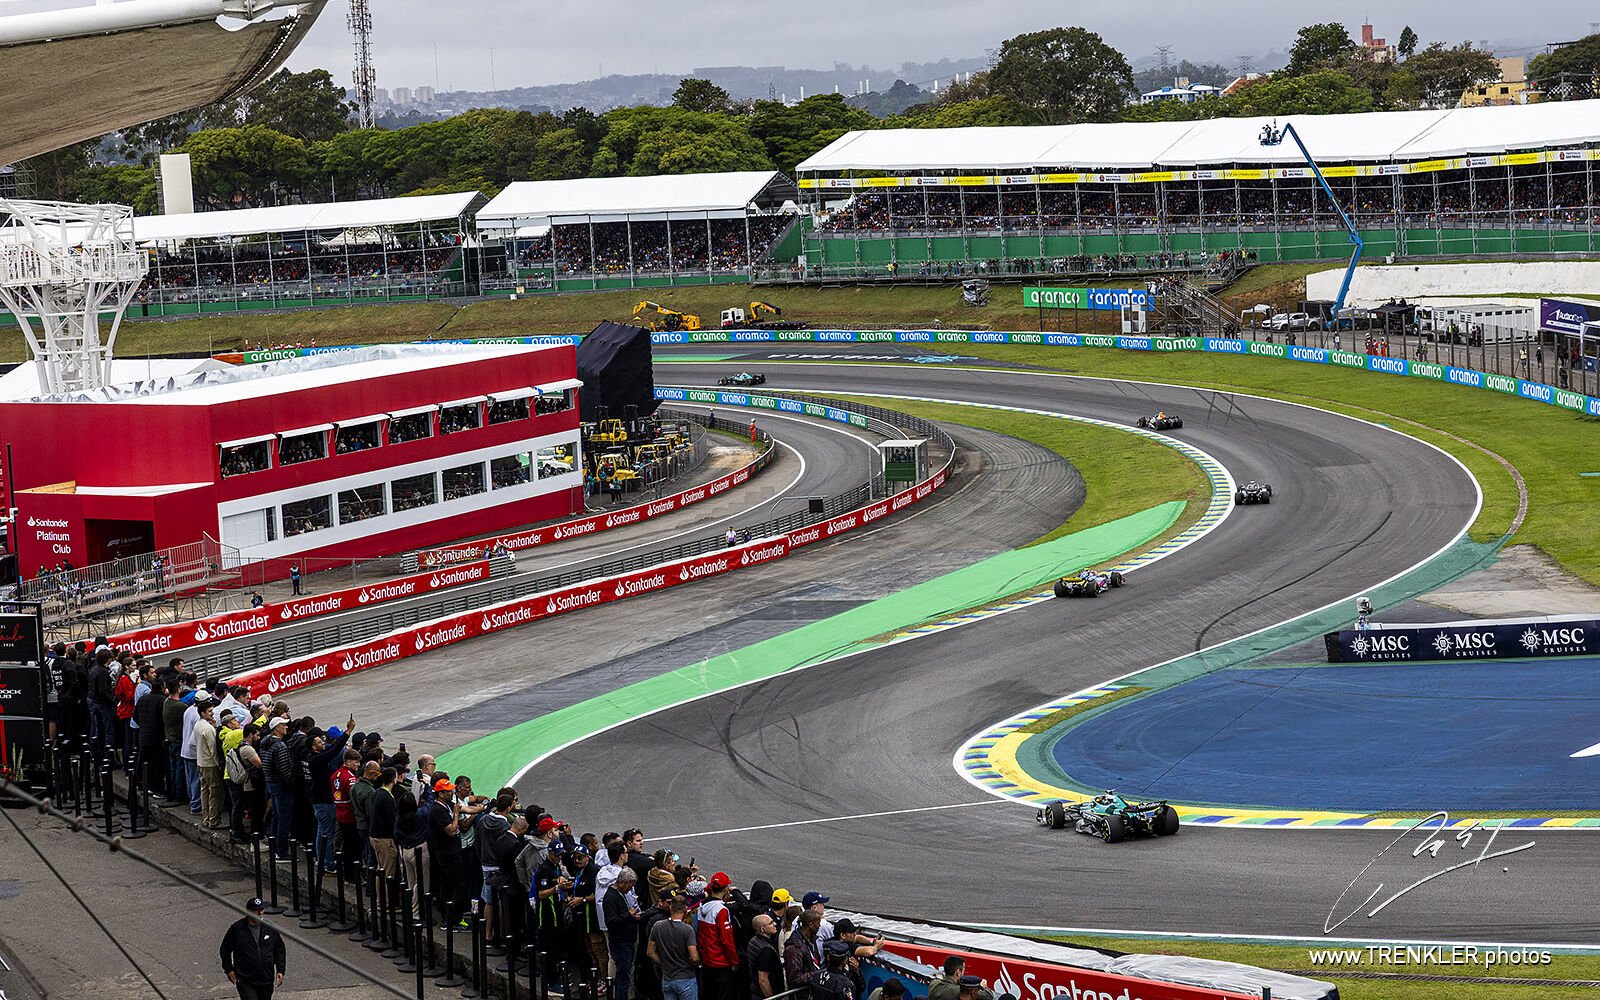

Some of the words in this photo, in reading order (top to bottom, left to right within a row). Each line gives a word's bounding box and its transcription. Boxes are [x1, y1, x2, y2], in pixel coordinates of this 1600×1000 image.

[1031, 292, 1080, 304] aramco
[1096, 292, 1146, 305] aramco
[650, 333, 682, 342] amco
[736, 332, 770, 341] aramco
[779, 332, 811, 340] aramco
[901, 332, 929, 340] aramco
[938, 333, 967, 341] aramco
[975, 334, 1003, 342] aramco
[1012, 334, 1040, 342] aramco
[1049, 336, 1077, 344] aramco
[1086, 337, 1112, 346] aramco
[1120, 338, 1148, 348] aramco
[1156, 338, 1196, 349] aramco
[1210, 340, 1241, 352] aramco
[1251, 344, 1283, 356] aramco
[251, 350, 296, 361] aramco
[1292, 348, 1323, 360] aramco
[1332, 353, 1363, 366] aramco
[1372, 358, 1403, 372] aramco
[1412, 364, 1442, 378] aramco
[1450, 369, 1478, 385] aramco
[1487, 375, 1514, 392] aramco
[656, 390, 682, 399] aramco
[690, 391, 716, 402] aramco
[1522, 382, 1550, 400] aramco
[722, 394, 746, 404] aramco
[752, 396, 774, 408] aramco
[1557, 391, 1583, 410] aramco
[714, 480, 730, 493] Santander
[685, 489, 704, 504] Santander
[896, 493, 912, 508] Santander
[652, 500, 674, 515] Santander
[868, 505, 887, 520] Santander
[36, 519, 68, 528] Santander
[612, 510, 640, 526] Santander
[834, 517, 856, 532] Santander
[37, 531, 70, 540] Platinum
[563, 521, 595, 538] Santander
[792, 528, 819, 545] Santander
[504, 534, 541, 549] Santander
[53, 544, 70, 554] Club
[750, 546, 784, 562] Santander
[690, 558, 727, 578] Santander
[442, 567, 482, 585] Santander
[370, 582, 415, 600] Santander
[626, 575, 664, 594] Santander
[293, 598, 342, 616] Santander
[558, 590, 600, 610] Santander
[492, 608, 530, 627] Santander
[210, 616, 269, 638] Santander
[426, 626, 466, 647] Santander
[1454, 632, 1496, 649] MSC
[1542, 628, 1584, 646] MSC
[1371, 636, 1409, 652] MSC
[354, 643, 400, 666] Santander
[280, 664, 327, 688] Santander
